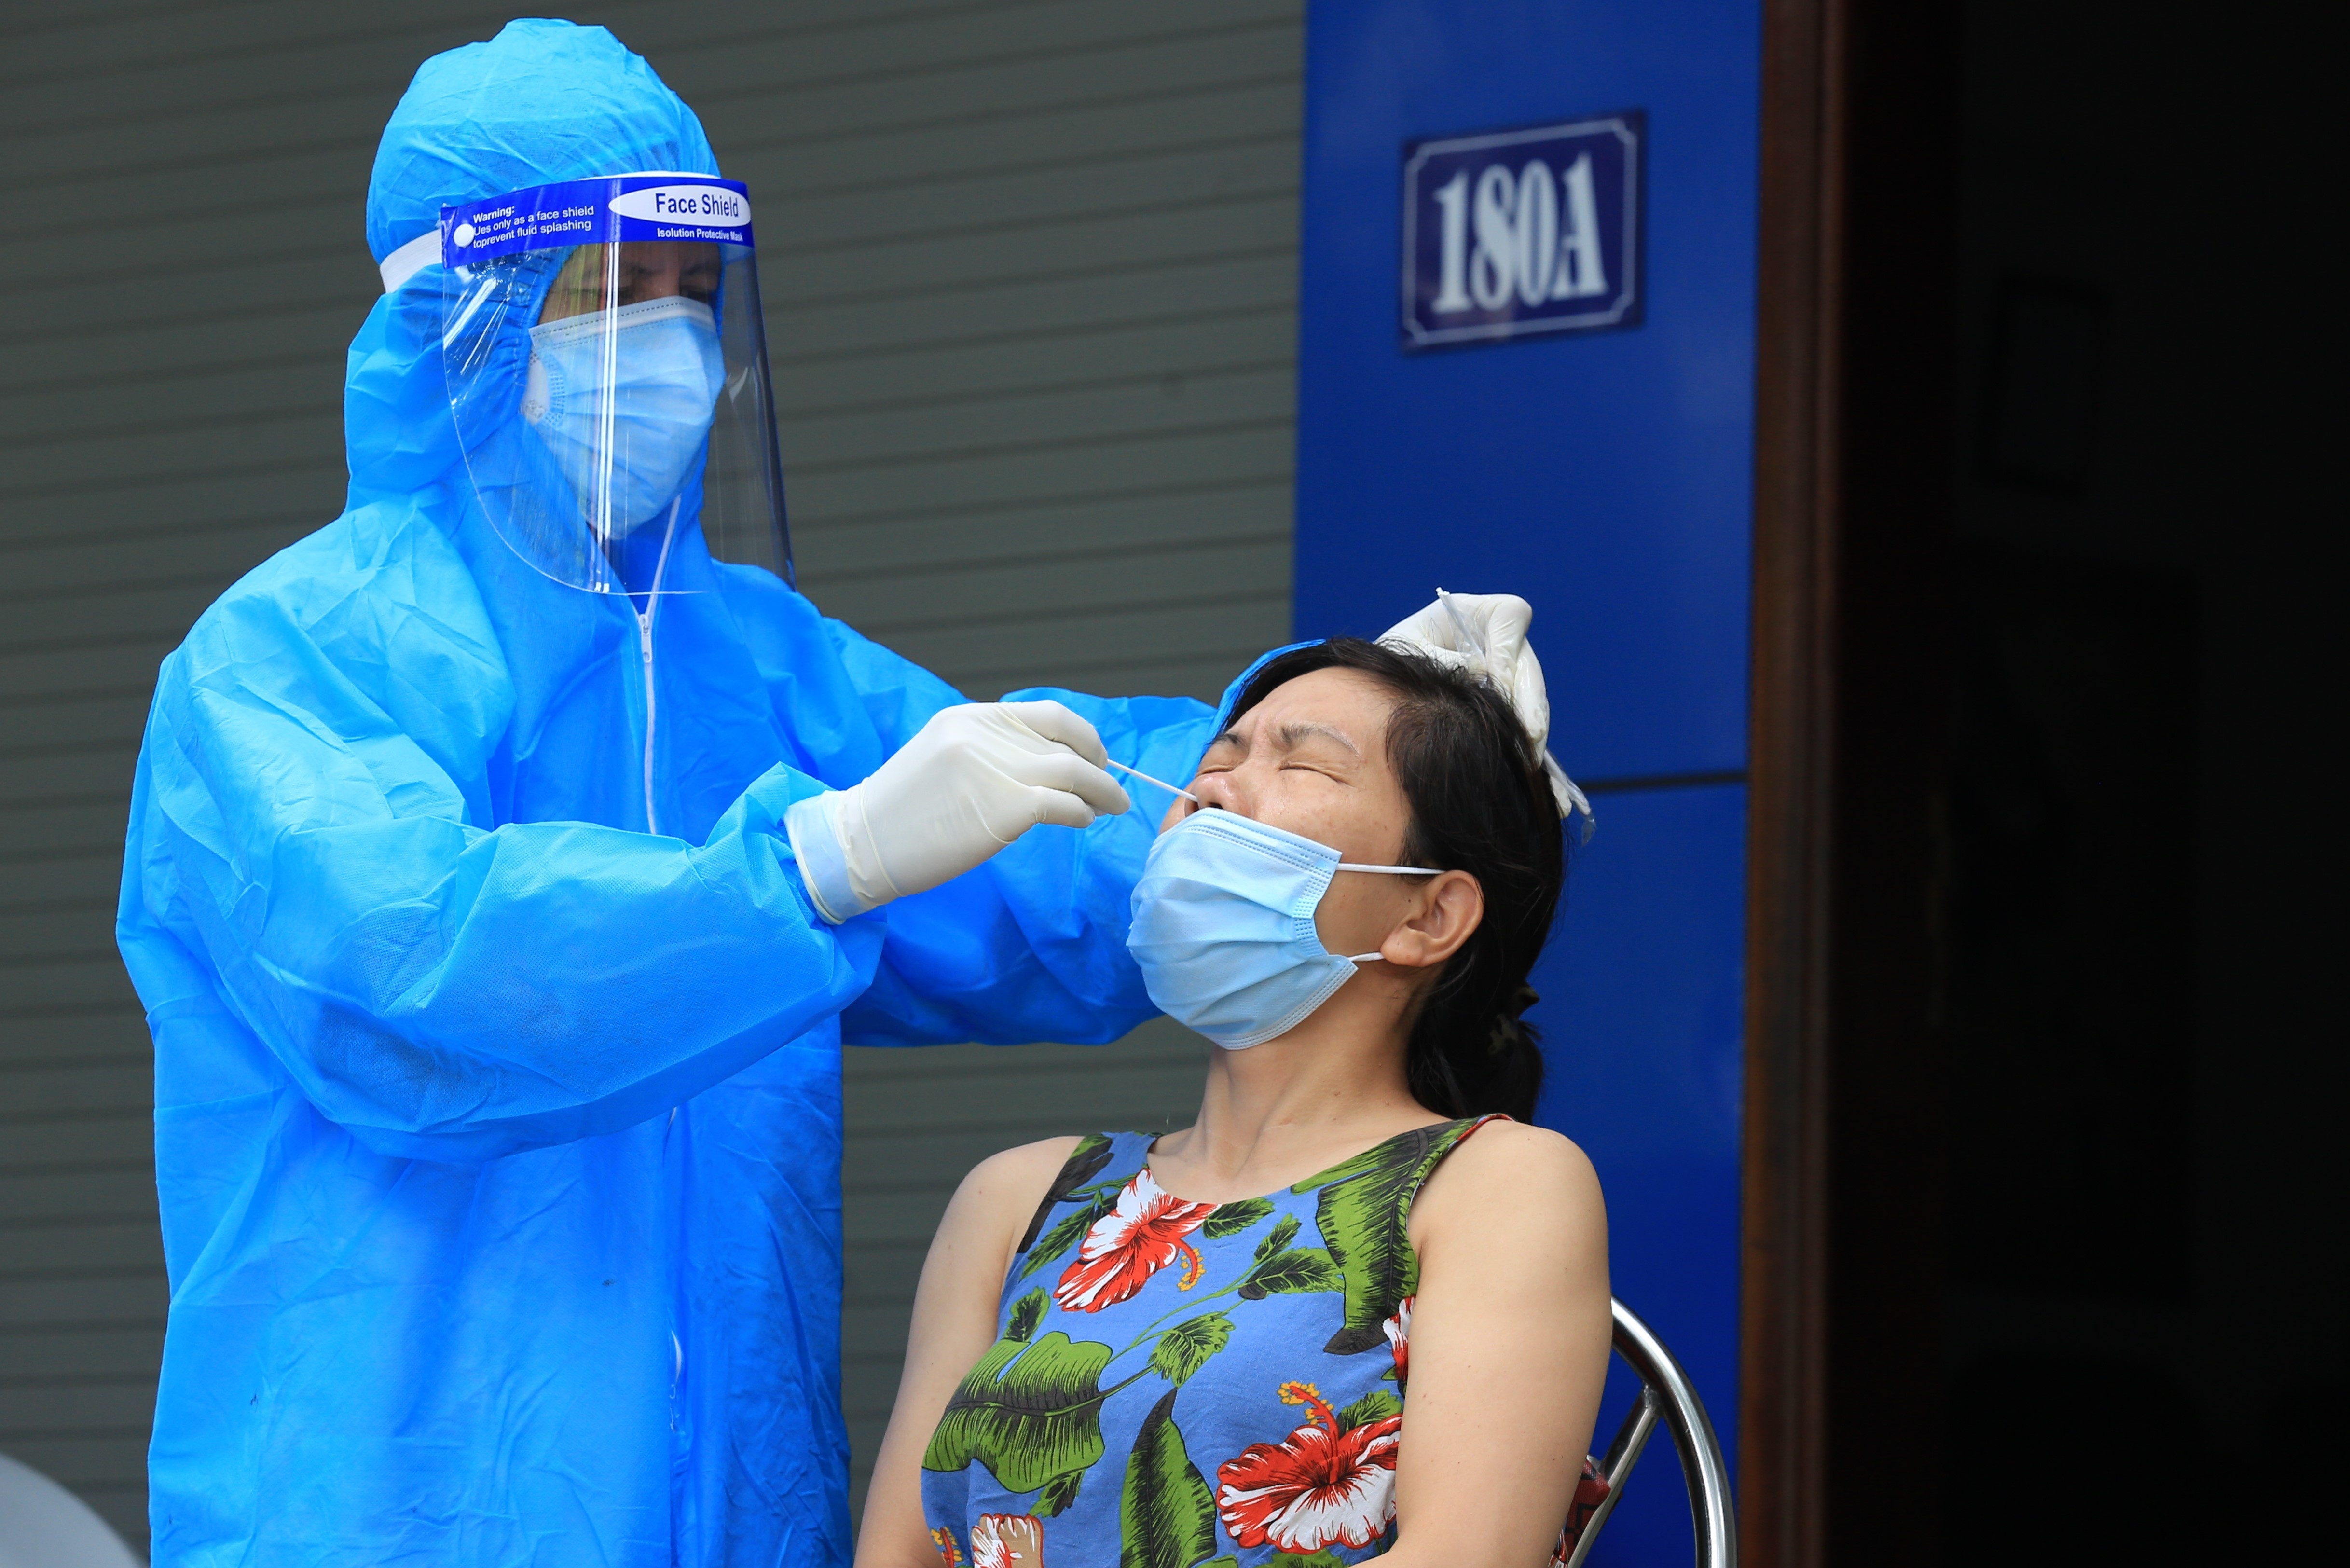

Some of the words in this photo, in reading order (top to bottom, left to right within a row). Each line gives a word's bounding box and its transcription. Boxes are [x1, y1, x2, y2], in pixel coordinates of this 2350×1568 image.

[473, 206, 515, 223] Warning:
[656, 193, 697, 213] Face
[702, 194, 738, 217] Shield
[493, 219, 511, 231] only
[514, 217, 525, 225] as
[537, 211, 559, 221] face
[562, 206, 594, 218] shield
[473, 231, 515, 248] toprevent
[517, 225, 537, 237] fluid
[540, 221, 591, 234] splashing
[657, 228, 695, 237] Isolution
[696, 229, 729, 240] Protective
[730, 231, 743, 242] Mask
[1430, 148, 1608, 314] 180A
